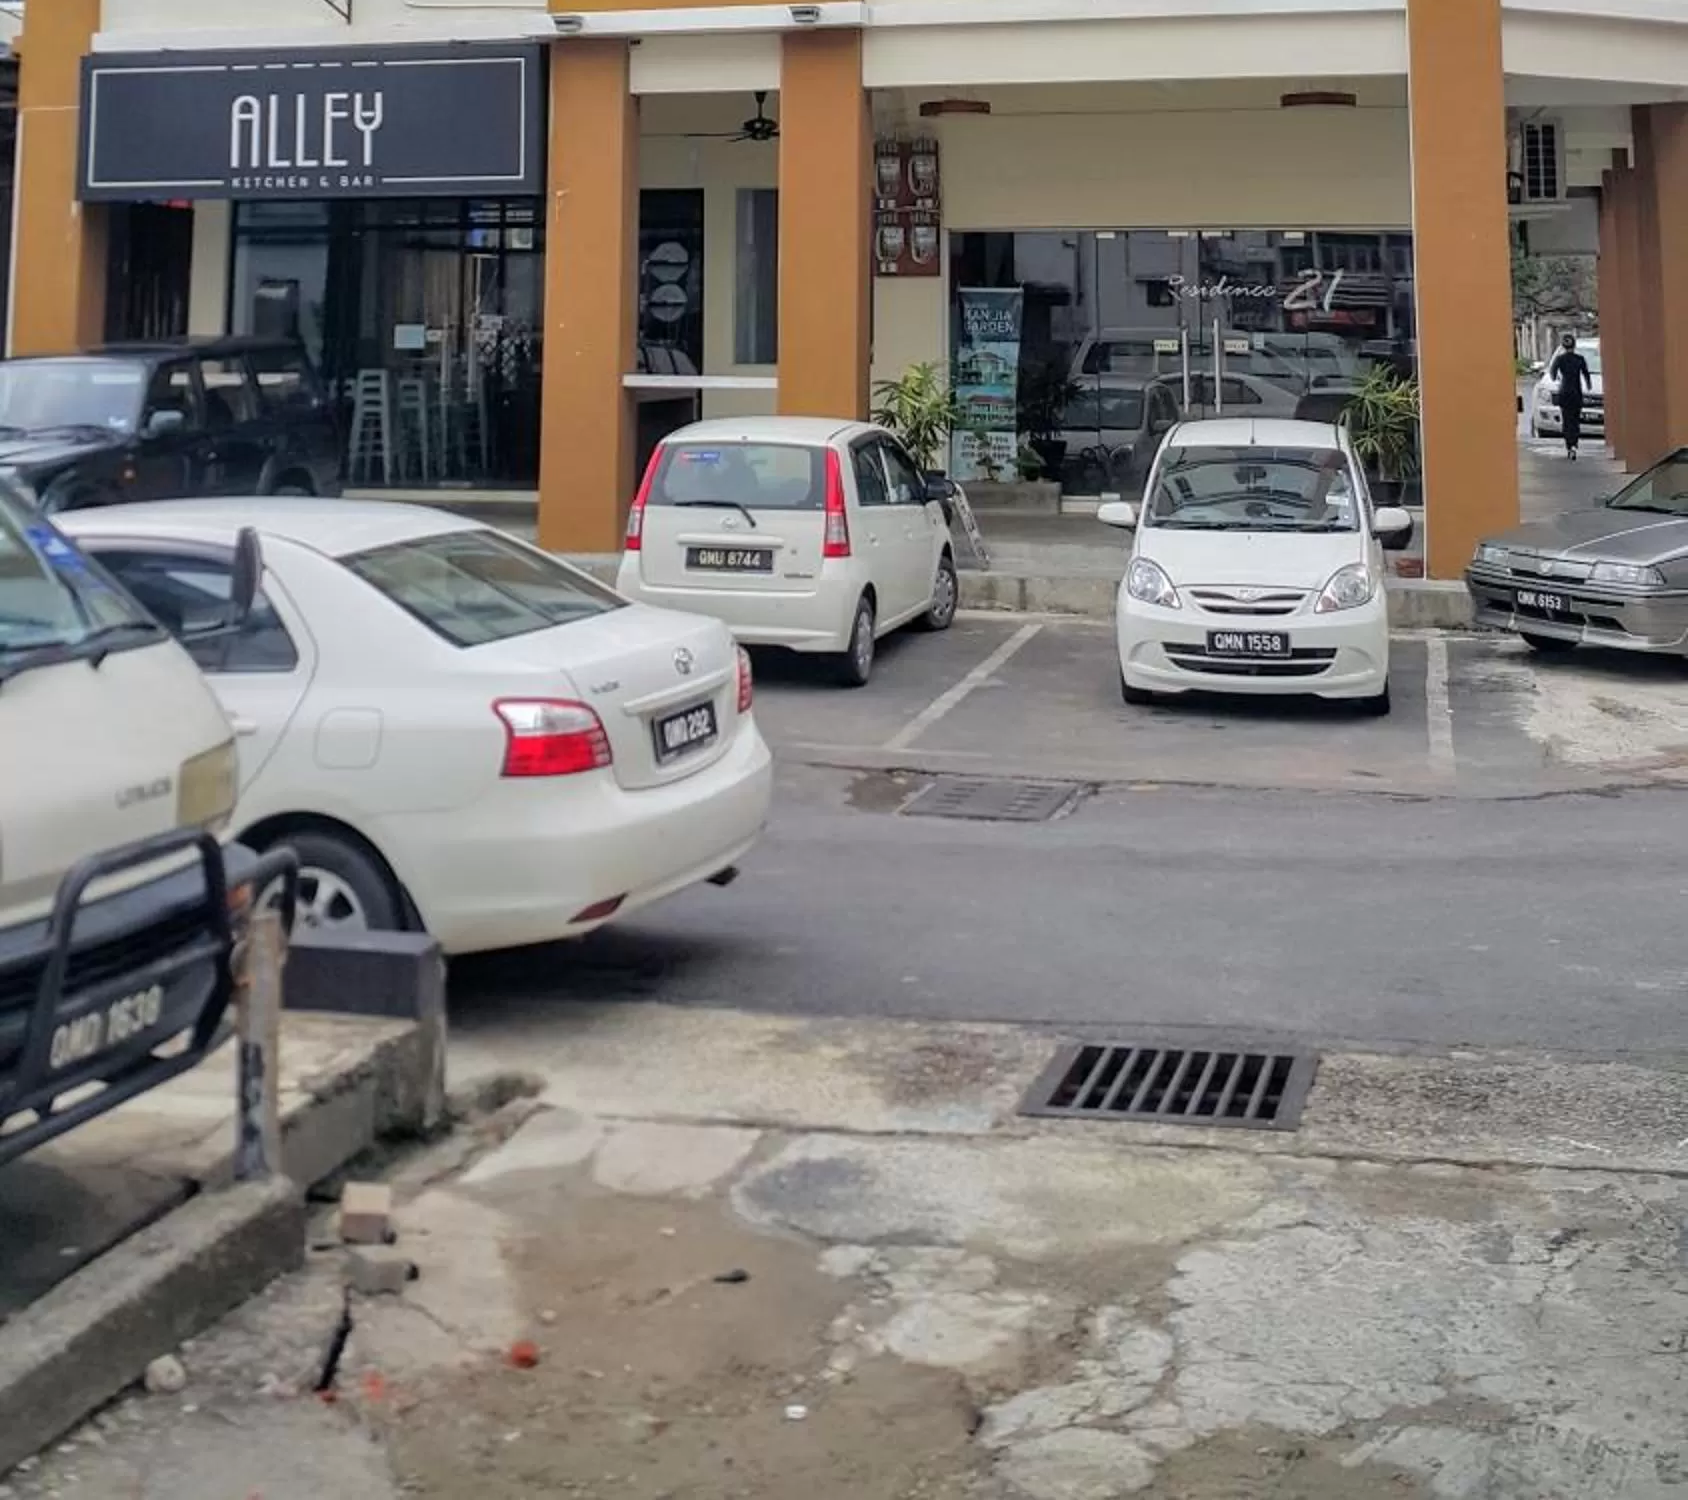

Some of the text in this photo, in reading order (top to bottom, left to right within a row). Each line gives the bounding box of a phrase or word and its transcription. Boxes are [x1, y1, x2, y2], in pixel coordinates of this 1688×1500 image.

[230, 91, 383, 168] ALLEY
[231, 175, 309, 188] KITCHEN
[339, 174, 374, 187] BAR
[1283, 267, 1345, 313] 21
[727, 551, 761, 567] 8744
[1215, 633, 1282, 651] QMN 1558
